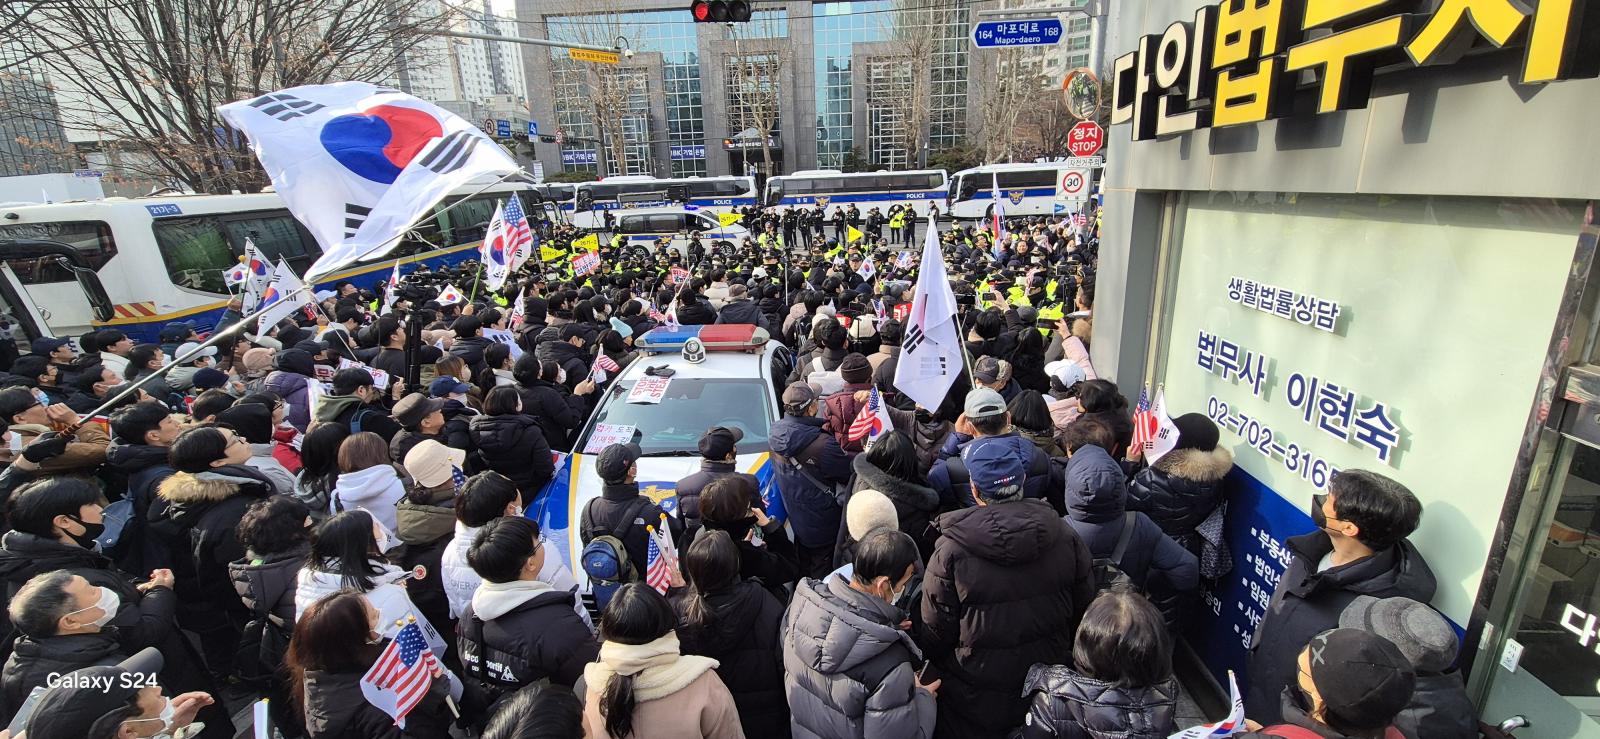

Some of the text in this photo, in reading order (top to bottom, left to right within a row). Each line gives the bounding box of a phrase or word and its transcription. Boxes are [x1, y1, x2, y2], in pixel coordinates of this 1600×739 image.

[978, 22, 1059, 39] 164 마포대로 168
[994, 36, 1041, 45] Mapo-daero
[1073, 126, 1098, 140] 정지
[1072, 141, 1097, 152] STOP
[1069, 159, 1100, 167] 자전거주의
[1066, 177, 1079, 187] 30
[1228, 275, 1340, 333] 생활법률상담
[1197, 330, 1401, 463] 법무사 이현숙
[1258, 529, 1296, 569] 부동산
[1560, 603, 1600, 656] 다
